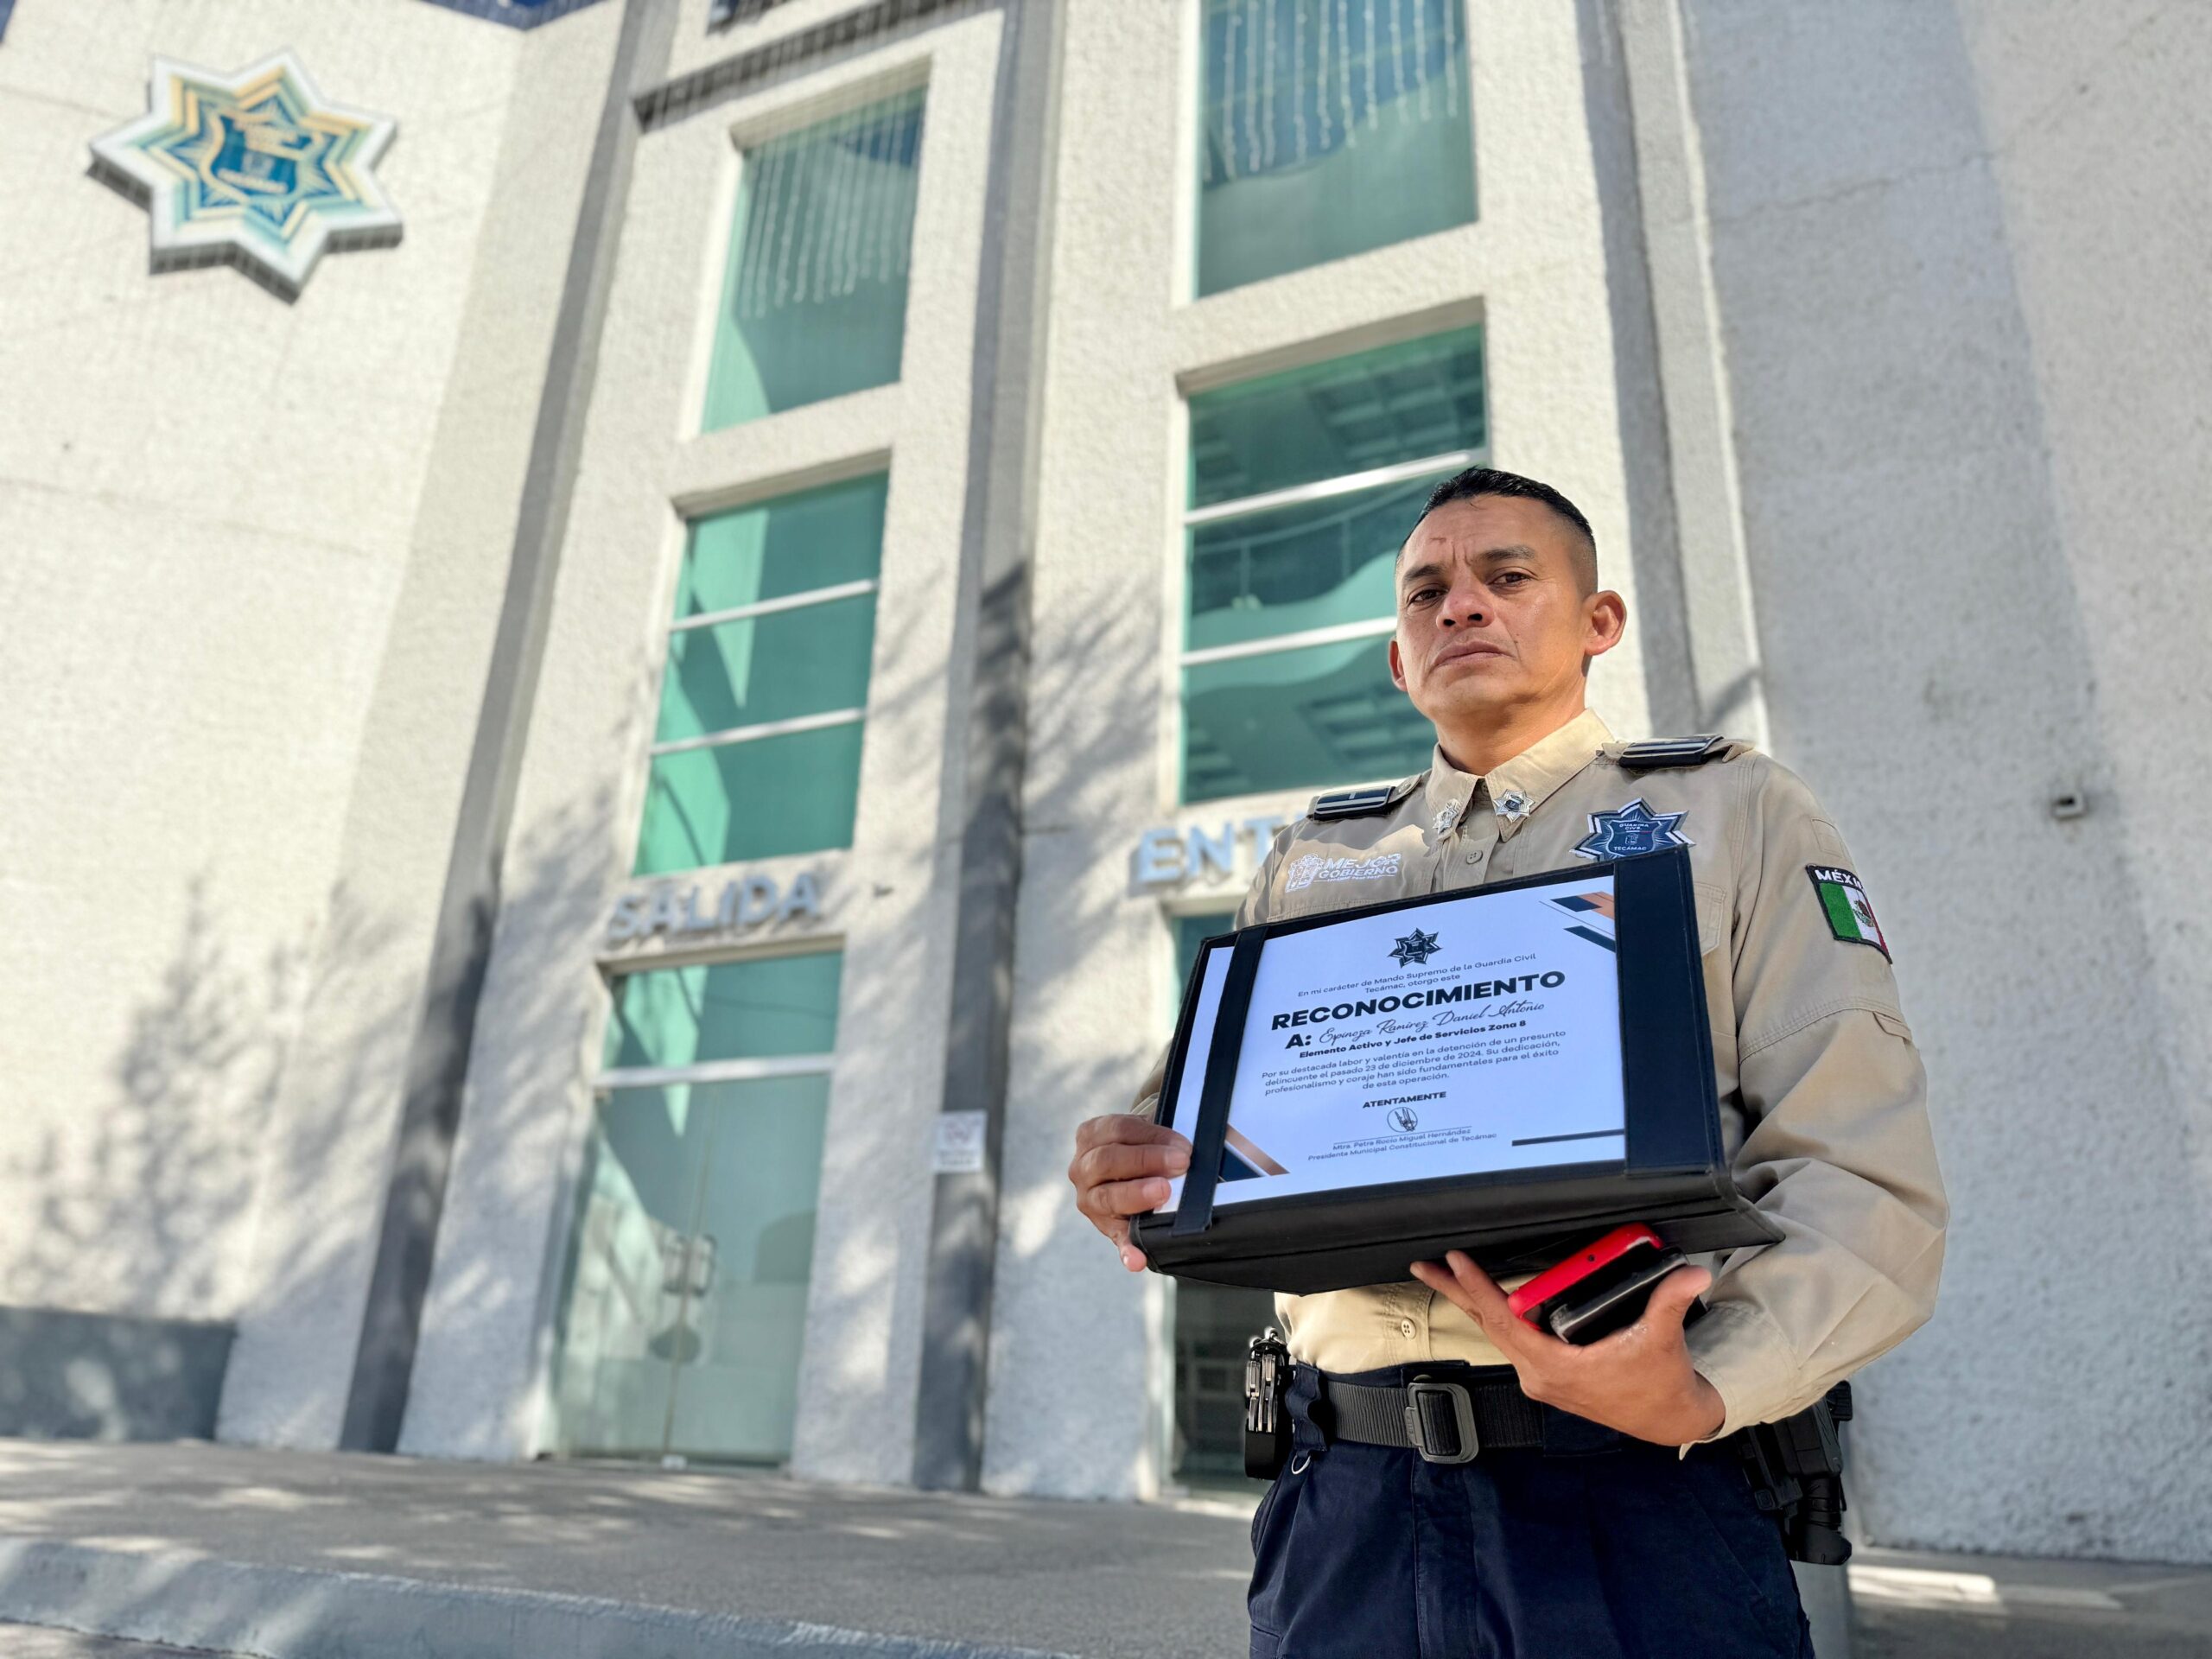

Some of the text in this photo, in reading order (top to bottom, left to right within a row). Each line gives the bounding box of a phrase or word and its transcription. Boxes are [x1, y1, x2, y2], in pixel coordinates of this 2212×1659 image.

[1137, 811, 1305, 882] ENT
[1325, 853, 1402, 869] MEJOR
[1319, 866, 1398, 879] GOBIERNO
[608, 871, 820, 939] SALIDA
[1324, 982, 1358, 994] carácter
[1374, 975, 1404, 985] Mando
[1407, 968, 1448, 981] Supremo
[1475, 957, 1512, 969] Guardia
[1514, 953, 1536, 963] Civil
[1365, 982, 1406, 995] Tecámac,
[1408, 977, 1439, 988] otorgo
[1271, 970, 1566, 1031] RECONOCIMIENTO
[1285, 1033, 1312, 1049] A:
[1432, 1003, 1491, 1027] Daniel
[1487, 999, 1545, 1018] Antonio
[1300, 1046, 1347, 1058] Elemento
[1348, 1040, 1382, 1052] Activo
[1394, 1036, 1417, 1045] Jefe
[1419, 1033, 1433, 1042] de
[1434, 1027, 1486, 1039] Servicios
[1489, 1022, 1517, 1032] Zona
[1265, 1073, 1319, 1087] delincuente
[1331, 1066, 1363, 1078] pasado
[1392, 1057, 1441, 1069] diciembre
[1502, 1040, 1560, 1053] dedicación,
[1291, 1062, 1338, 1075] destacada
[1339, 1058, 1363, 1068] labor
[1373, 1051, 1410, 1062] valentía
[1437, 1039, 1487, 1053] detención
[1519, 1030, 1567, 1044] presunto
[1264, 1079, 1337, 1096] profesionalismo
[1346, 1073, 1376, 1084] coraje
[1376, 1071, 1395, 1079] han
[1397, 1068, 1417, 1077] sido
[1420, 1058, 1494, 1075] fundamentales
[1496, 1055, 1519, 1065] para
[1532, 1049, 1560, 1058] éxito
[1363, 1082, 1375, 1090] de
[1399, 1072, 1450, 1086] operación.
[1363, 1091, 1447, 1109] ATENTAMENTE
[1307, 1151, 1348, 1162] Presidenta
[1350, 1146, 1388, 1157] Municipal
[1389, 1139, 1446, 1151] Constitucional
[1461, 1132, 1497, 1142] Tecámac
[1354, 1141, 1375, 1149] Petra
[1399, 1134, 1427, 1143] Miguel
[1427, 1128, 1471, 1139] Hernández
